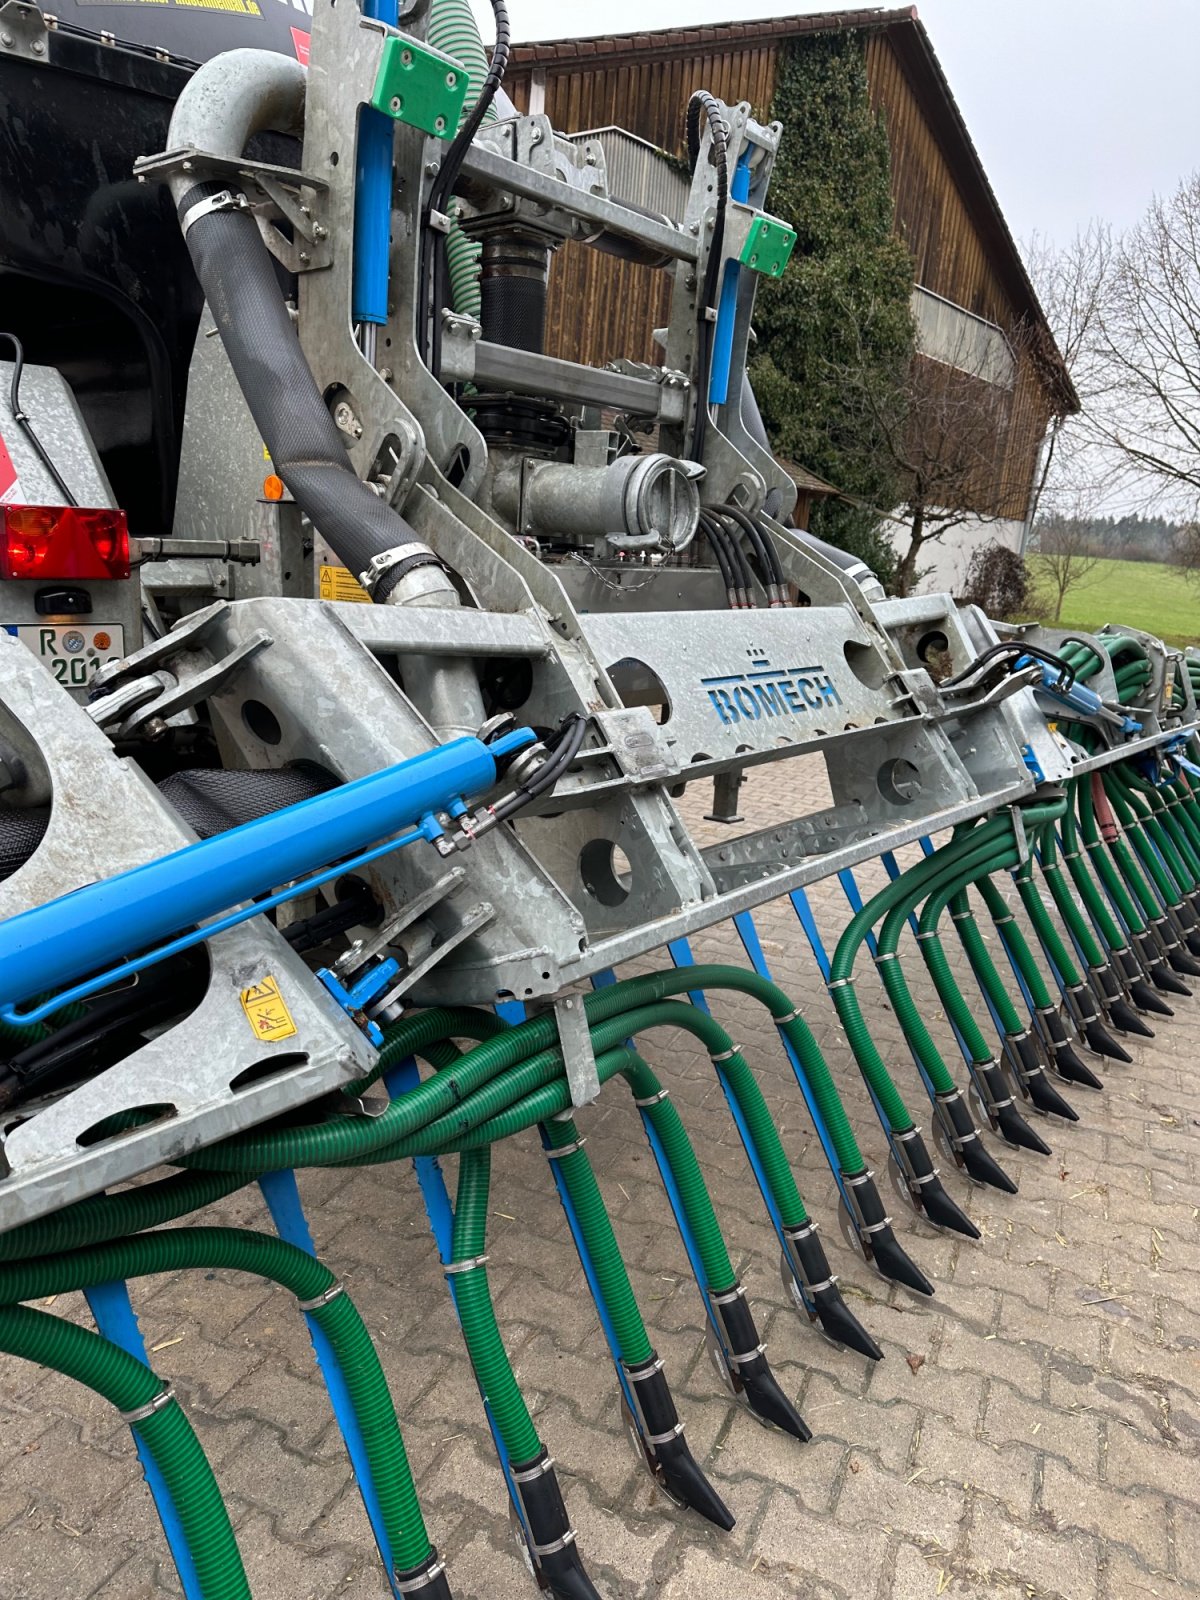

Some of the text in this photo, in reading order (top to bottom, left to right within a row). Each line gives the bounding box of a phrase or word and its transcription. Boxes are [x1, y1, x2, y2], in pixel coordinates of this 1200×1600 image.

[40, 629, 58, 655] R
[51, 656, 121, 684] 201
[707, 675, 843, 725] BOMECH
